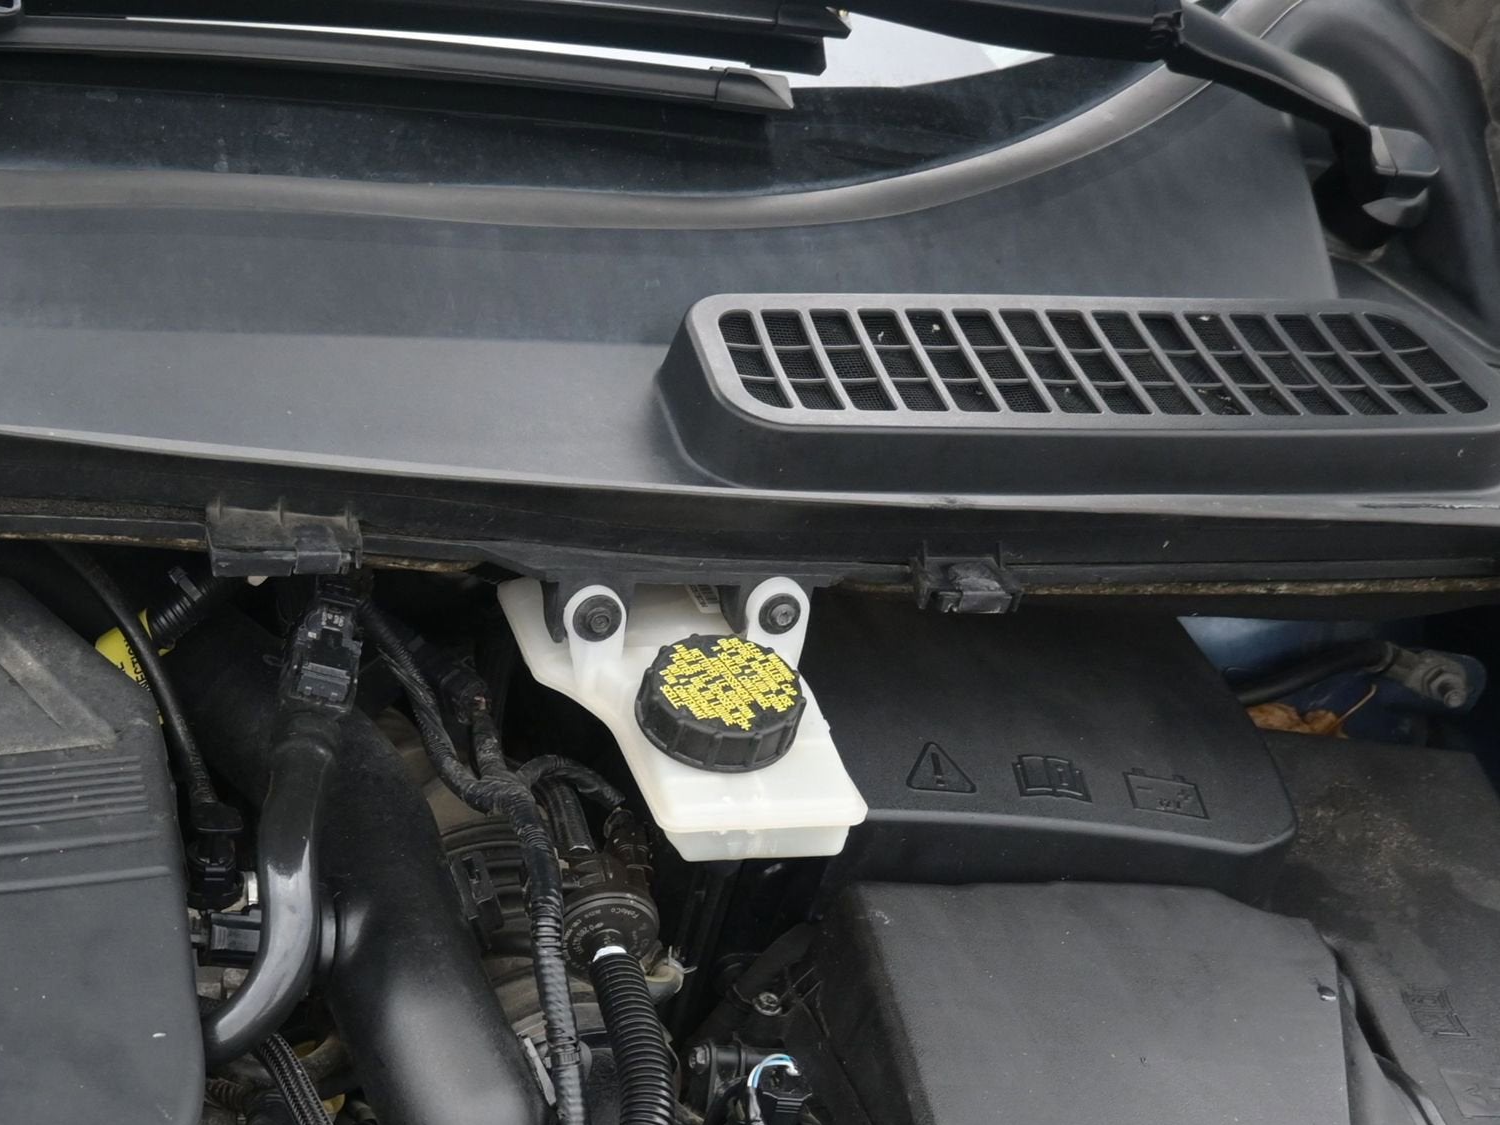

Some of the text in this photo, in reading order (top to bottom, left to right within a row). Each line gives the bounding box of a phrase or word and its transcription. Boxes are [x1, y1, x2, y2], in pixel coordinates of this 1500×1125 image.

[673, 644, 694, 662] AVANT
[718, 652, 742, 674] SEALED
[718, 638, 736, 652] ONLY
[732, 655, 748, 666] DOT
[749, 675, 769, 692] FLUID
[766, 694, 786, 712] FROM
[729, 638, 753, 659] BEFORE
[779, 694, 795, 706] USE
[745, 642, 797, 696] CLEAN FILLER CAP
[667, 664, 683, 676] DOT
[684, 684, 719, 718] PROVENANT
[669, 653, 694, 675] PLOYER
[691, 677, 706, 689] QUE
[710, 701, 736, 726] LIQUIDE
[673, 686, 708, 720] CONTENANT
[689, 648, 719, 677] NETTOYER
[725, 690, 756, 718] BOUCHON
[610, 907, 640, 919] FoMoCo
